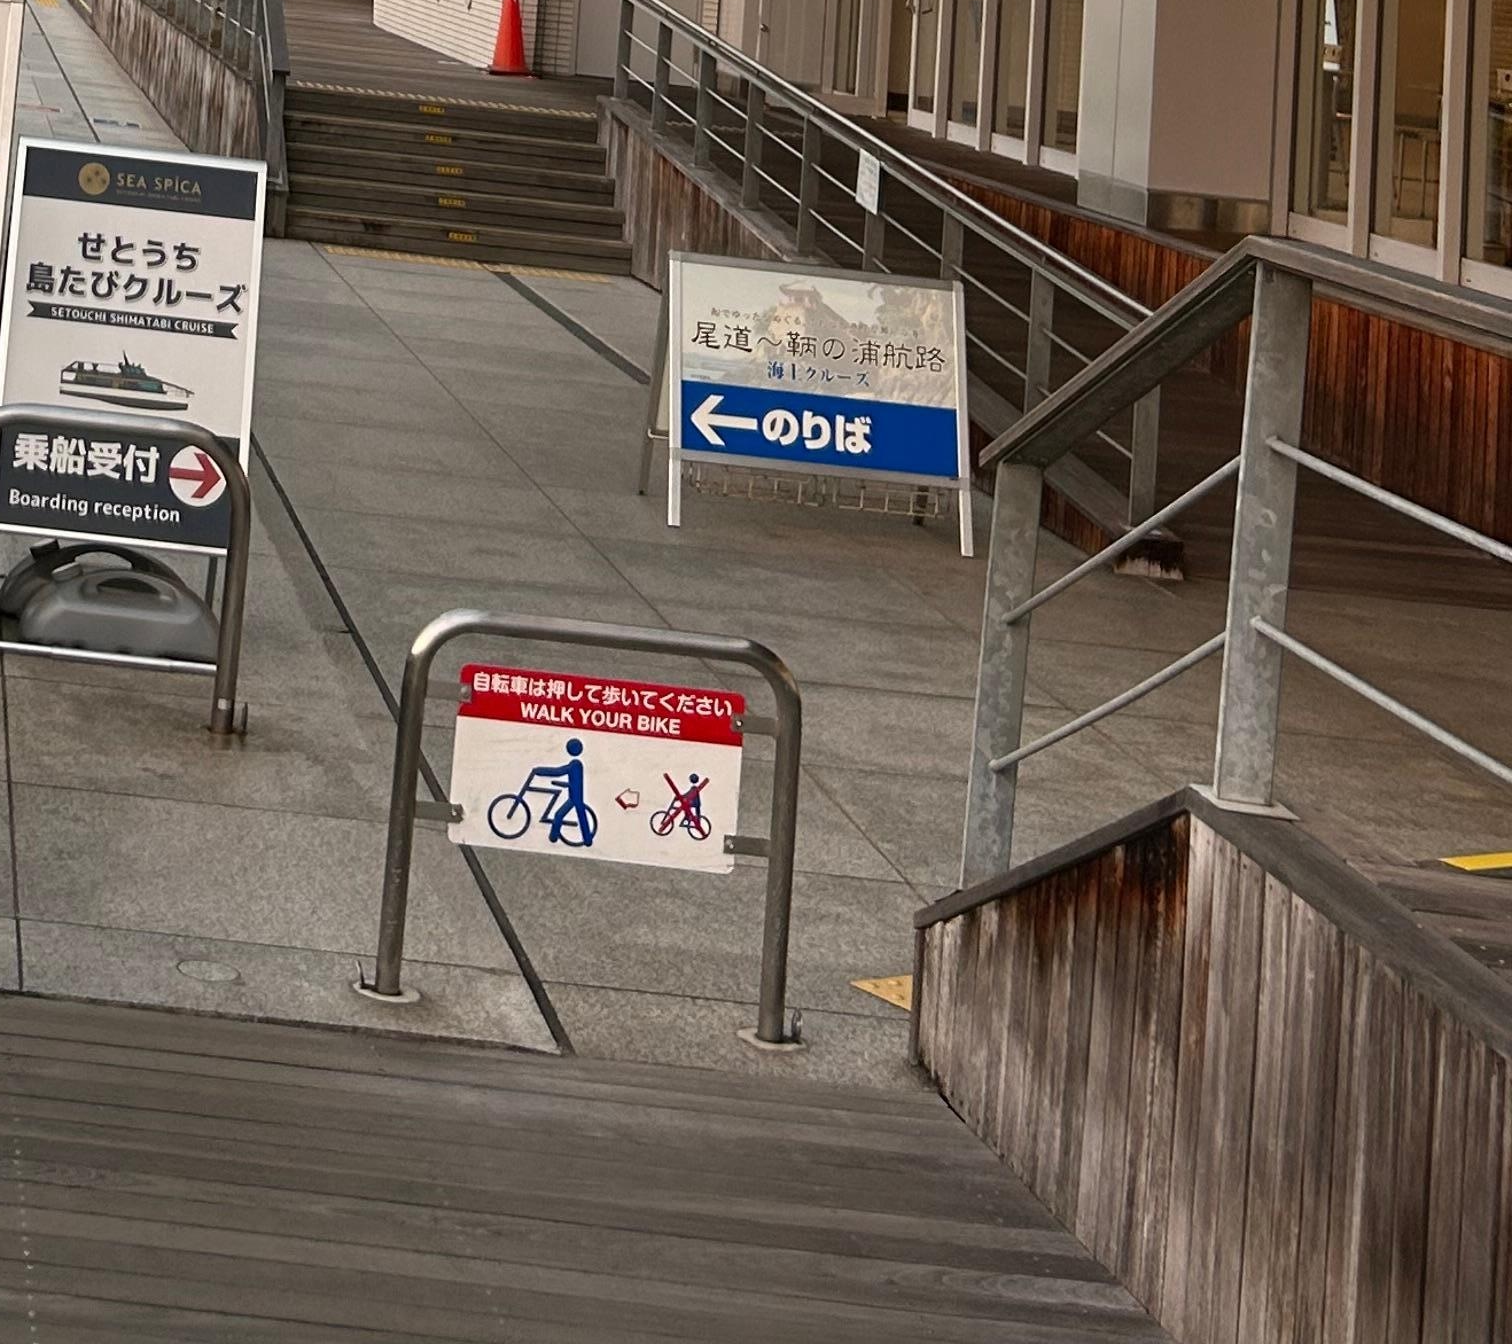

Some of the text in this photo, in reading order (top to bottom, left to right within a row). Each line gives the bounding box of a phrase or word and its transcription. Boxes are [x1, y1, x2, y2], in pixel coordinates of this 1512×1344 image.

[116, 173, 147, 189] SEA
[78, 232, 200, 272] せとうち
[26, 261, 248, 314] 島たびクルーズ
[51, 307, 214, 334] SETOUCHI SHIMATABI CRUISE
[762, 409, 872, 455] のりば
[13, 433, 160, 483] 乗船受付
[8, 488, 180, 523] Boarding reception
[473, 672, 733, 717] 自転車は押して歩いてください
[520, 702, 681, 735] WALK YOUR BIKE
